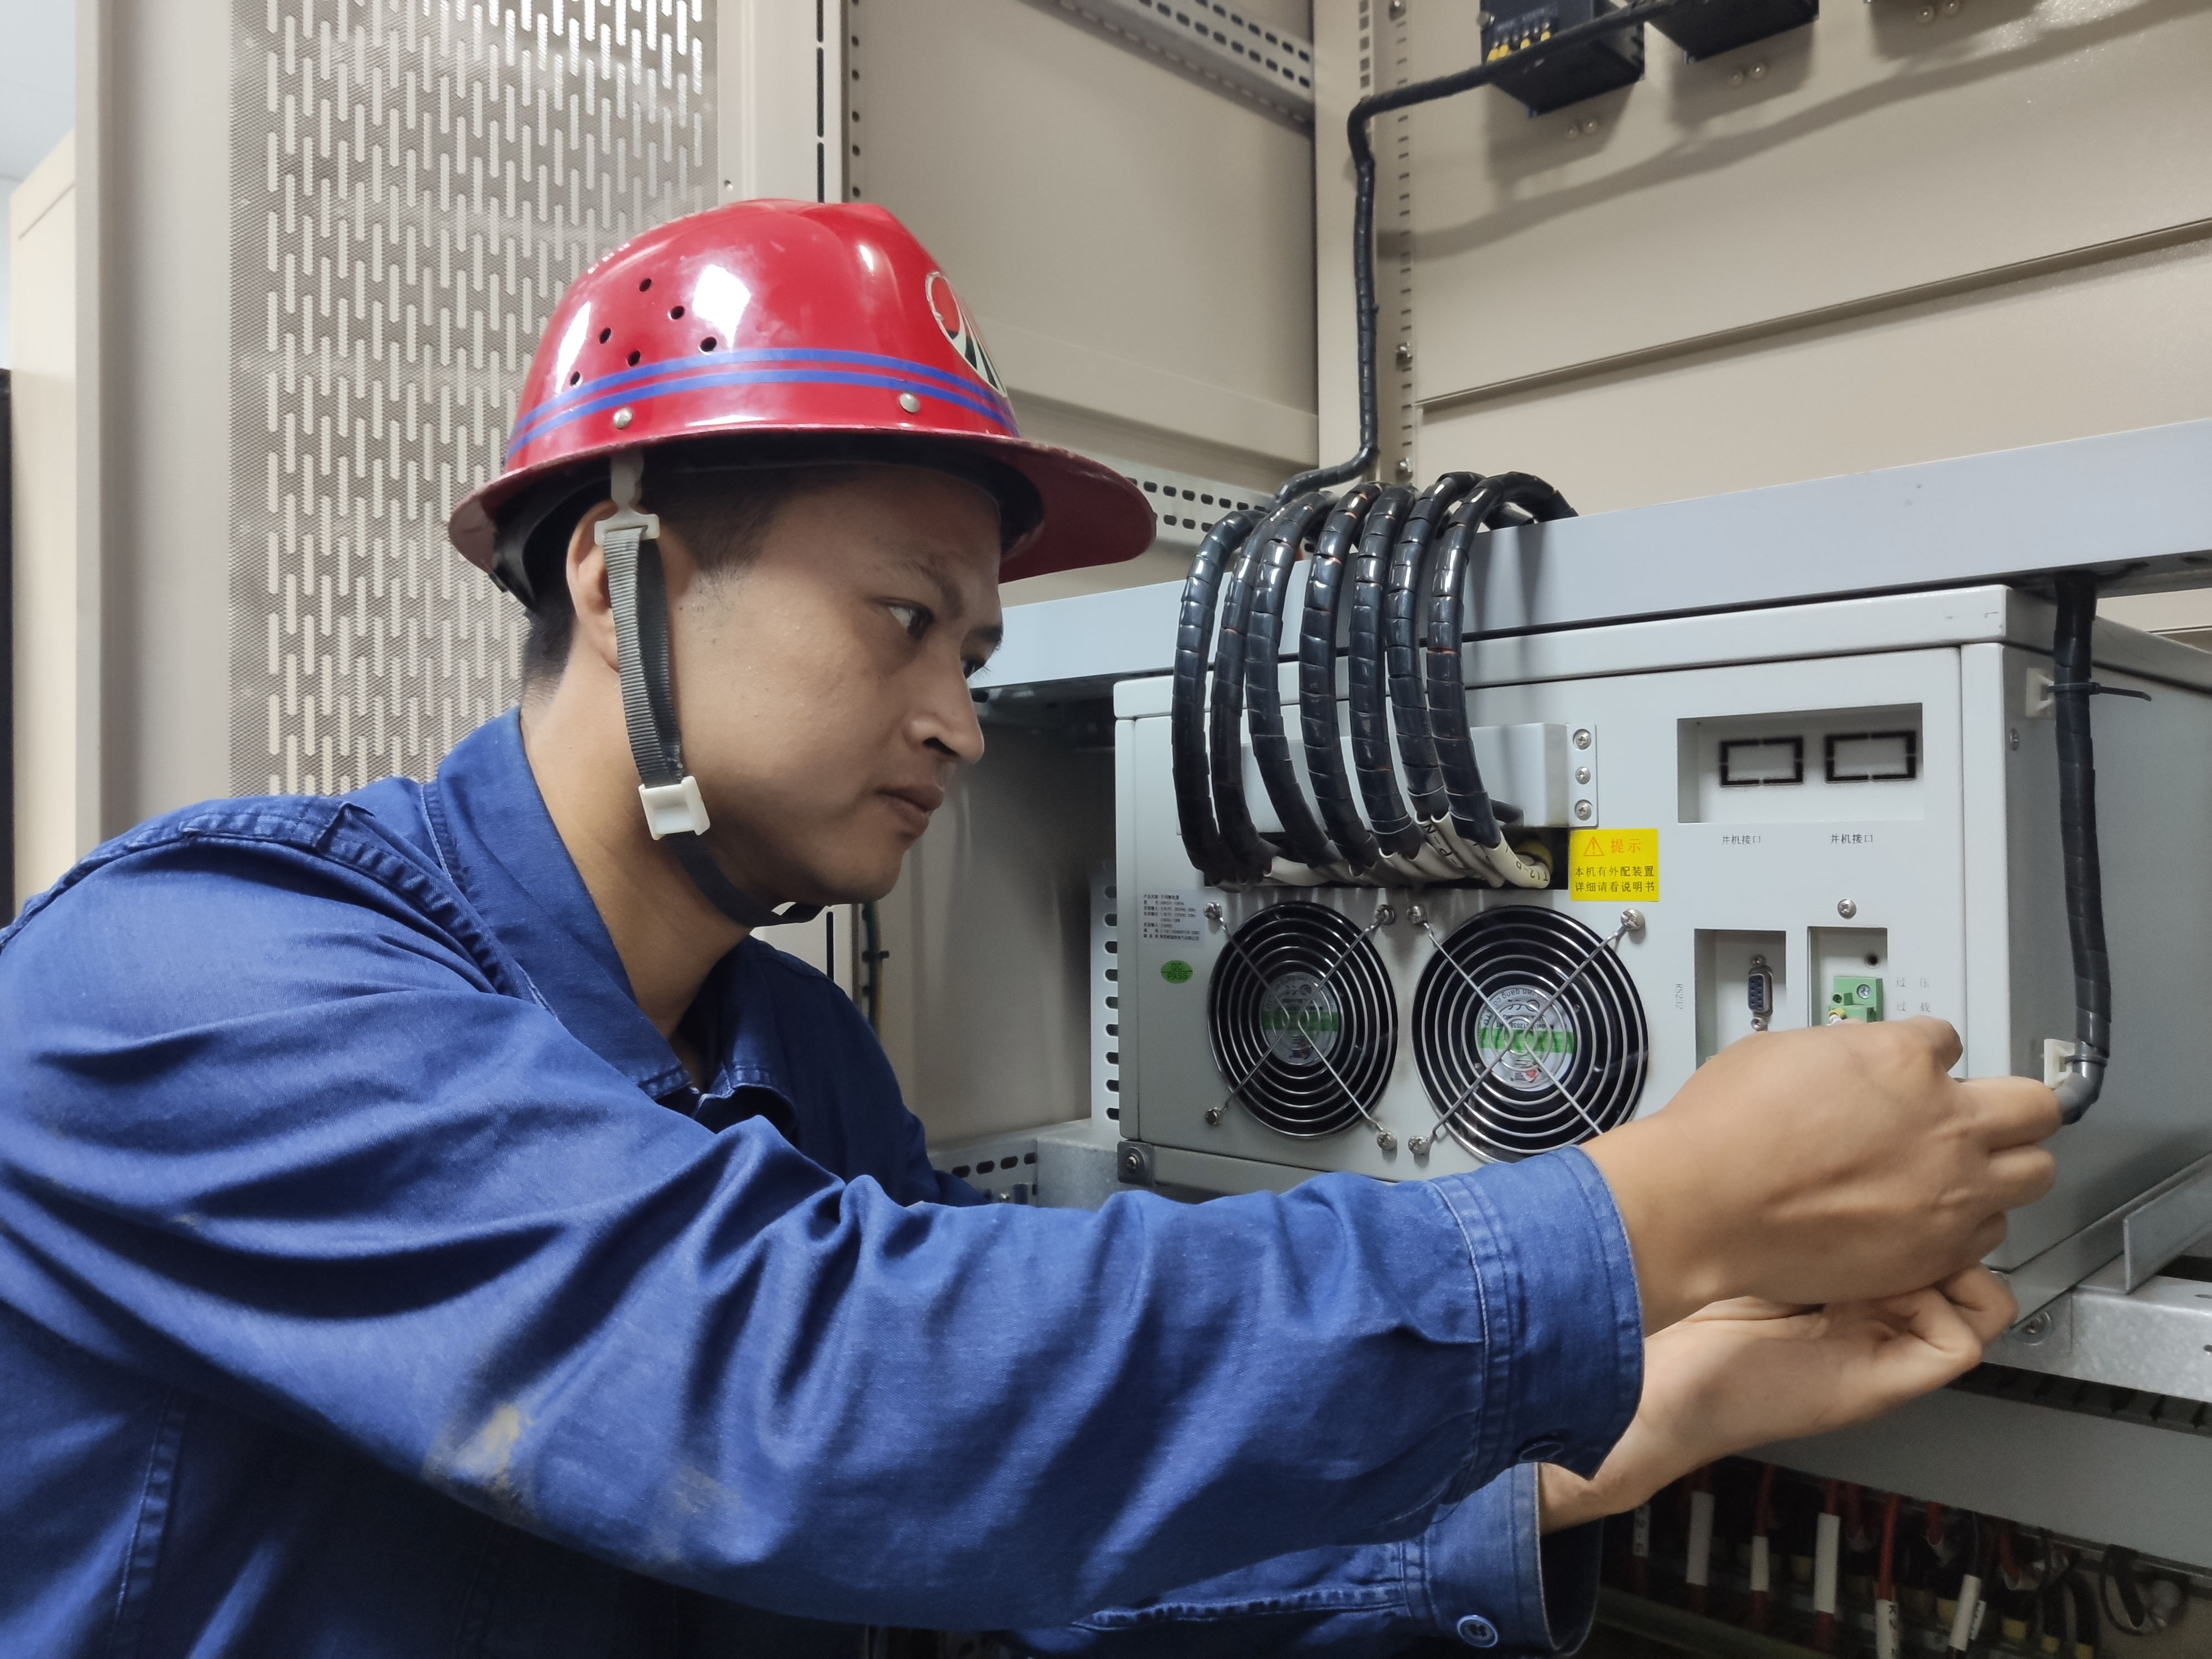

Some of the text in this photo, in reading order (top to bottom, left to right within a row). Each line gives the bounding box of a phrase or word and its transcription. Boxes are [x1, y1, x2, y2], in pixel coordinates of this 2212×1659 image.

[1830, 833, 1874, 844] 并机接口
[1610, 838, 1641, 853] 提示
[1574, 865, 1655, 877] 本机有外配装置
[1574, 881, 1655, 893] 详细请看说明书
[1171, 962, 1182, 971] QC
[1167, 972, 1188, 980] PASS
